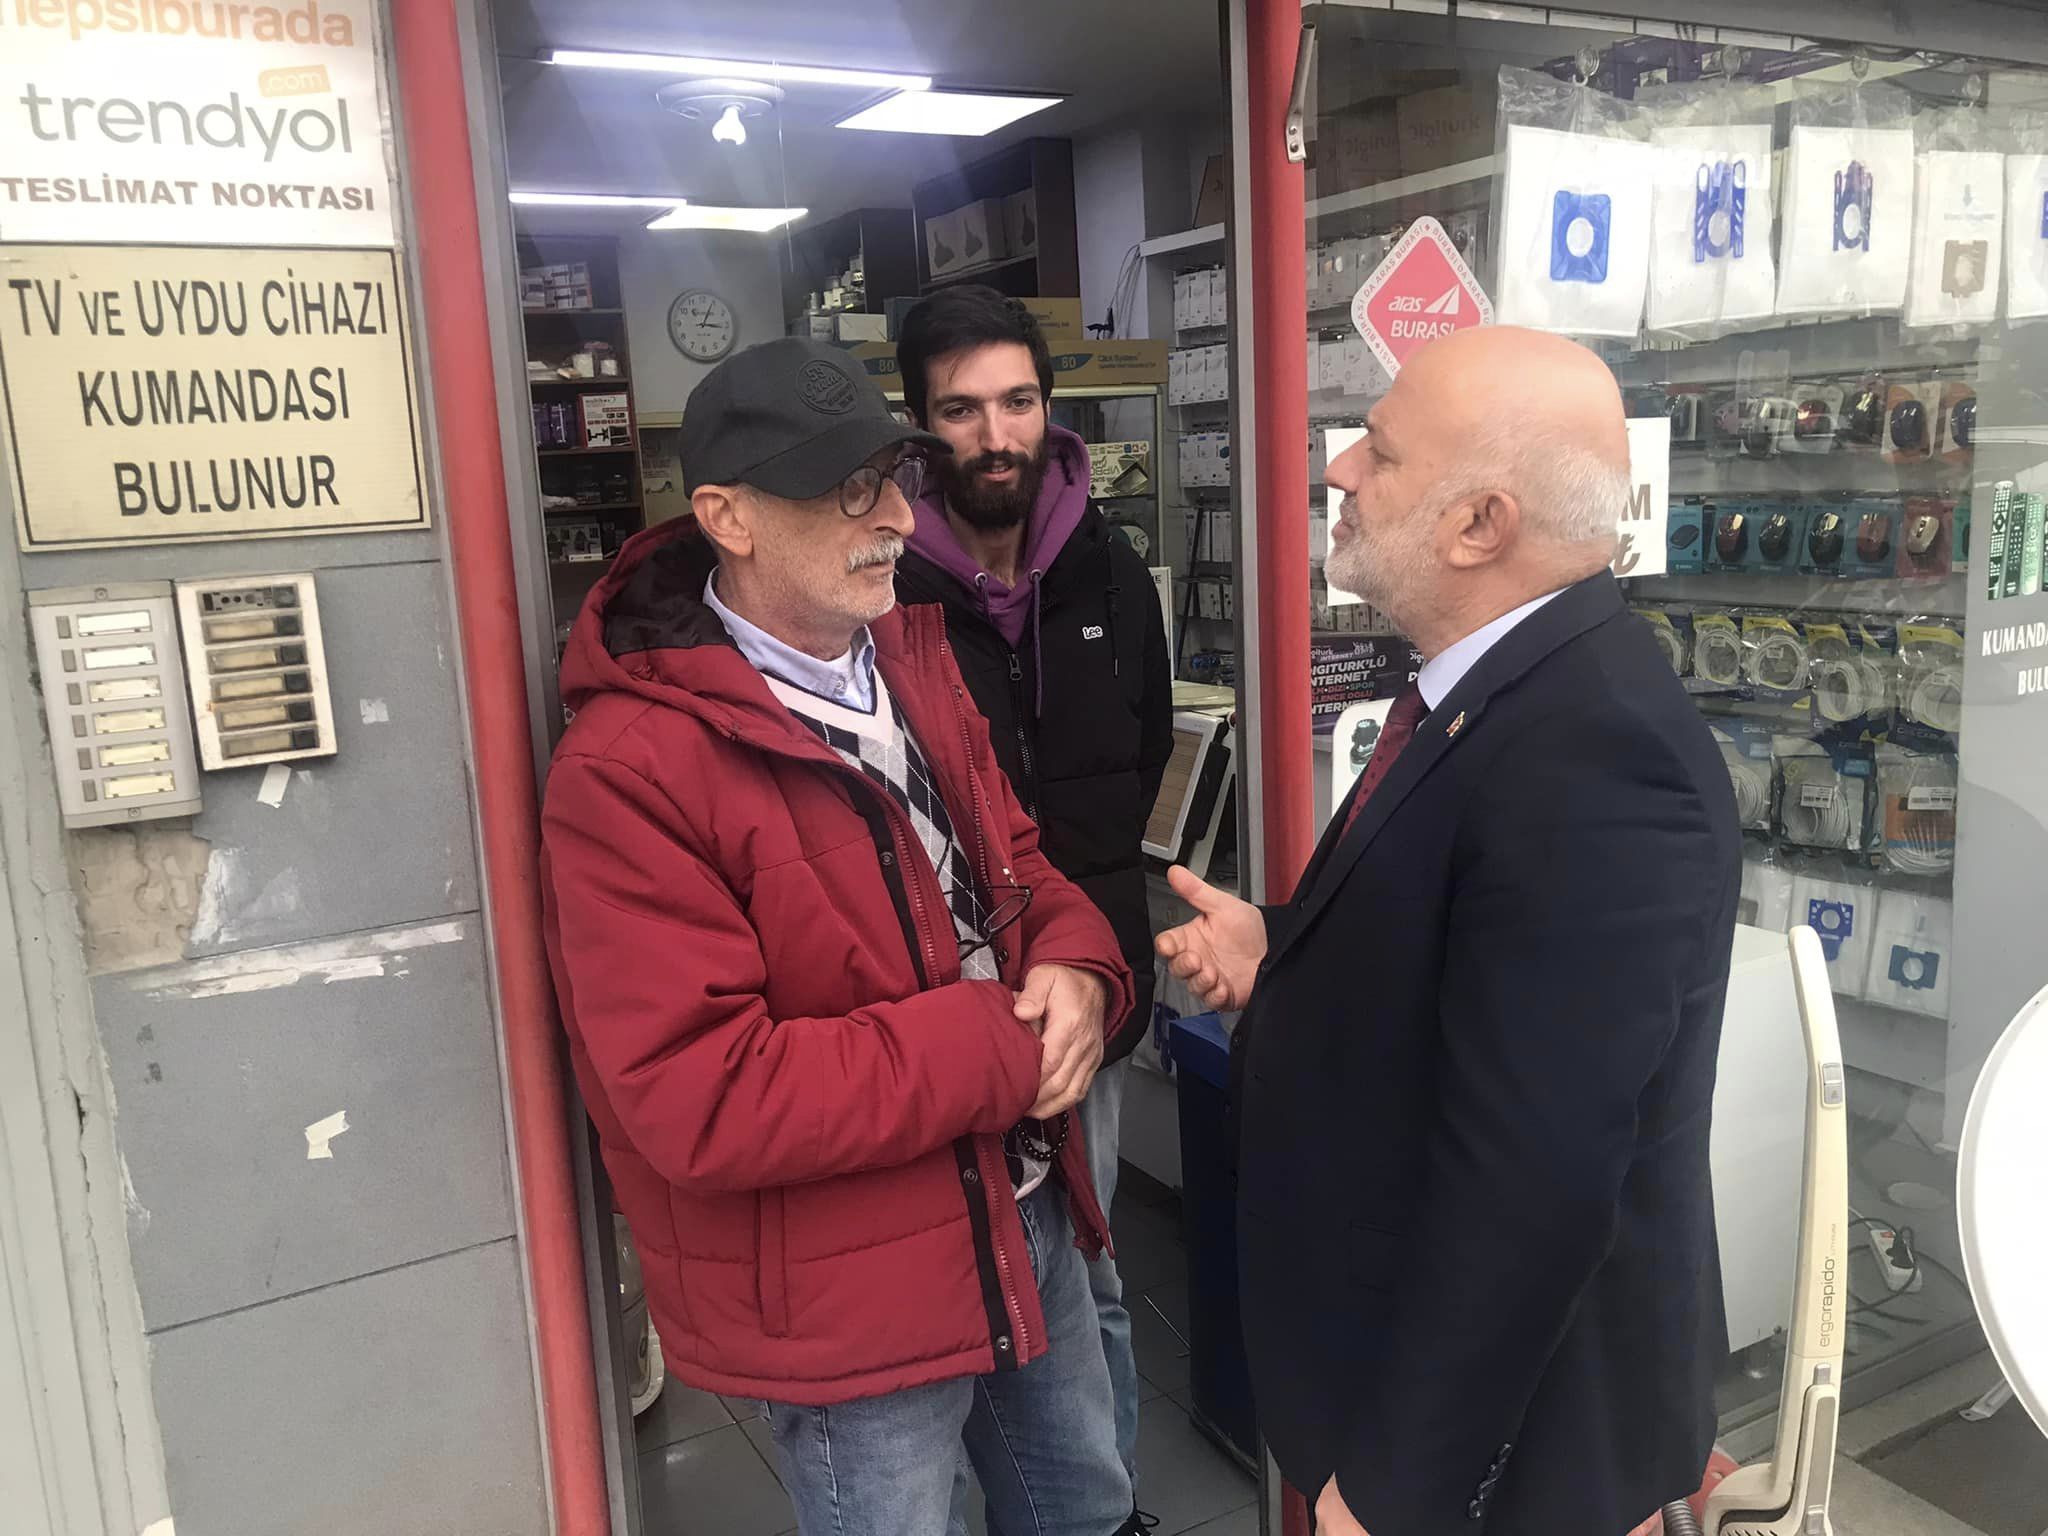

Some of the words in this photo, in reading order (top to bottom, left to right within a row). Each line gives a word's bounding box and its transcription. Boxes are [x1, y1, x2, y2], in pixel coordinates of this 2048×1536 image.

[20, 83, 353, 162] trendyol
[1, 173, 198, 205] TESLİMAT
[212, 181, 375, 211] NOKTASI
[9, 278, 61, 336] TV
[78, 291, 125, 336] VE
[134, 280, 248, 336] UYDU
[262, 268, 388, 336] CİHAZI
[1388, 296, 1422, 312] aras
[77, 366, 351, 427] KUMANDASI
[114, 455, 340, 516] BULUNUR
[1820, 1258, 1836, 1347] ergorapido
